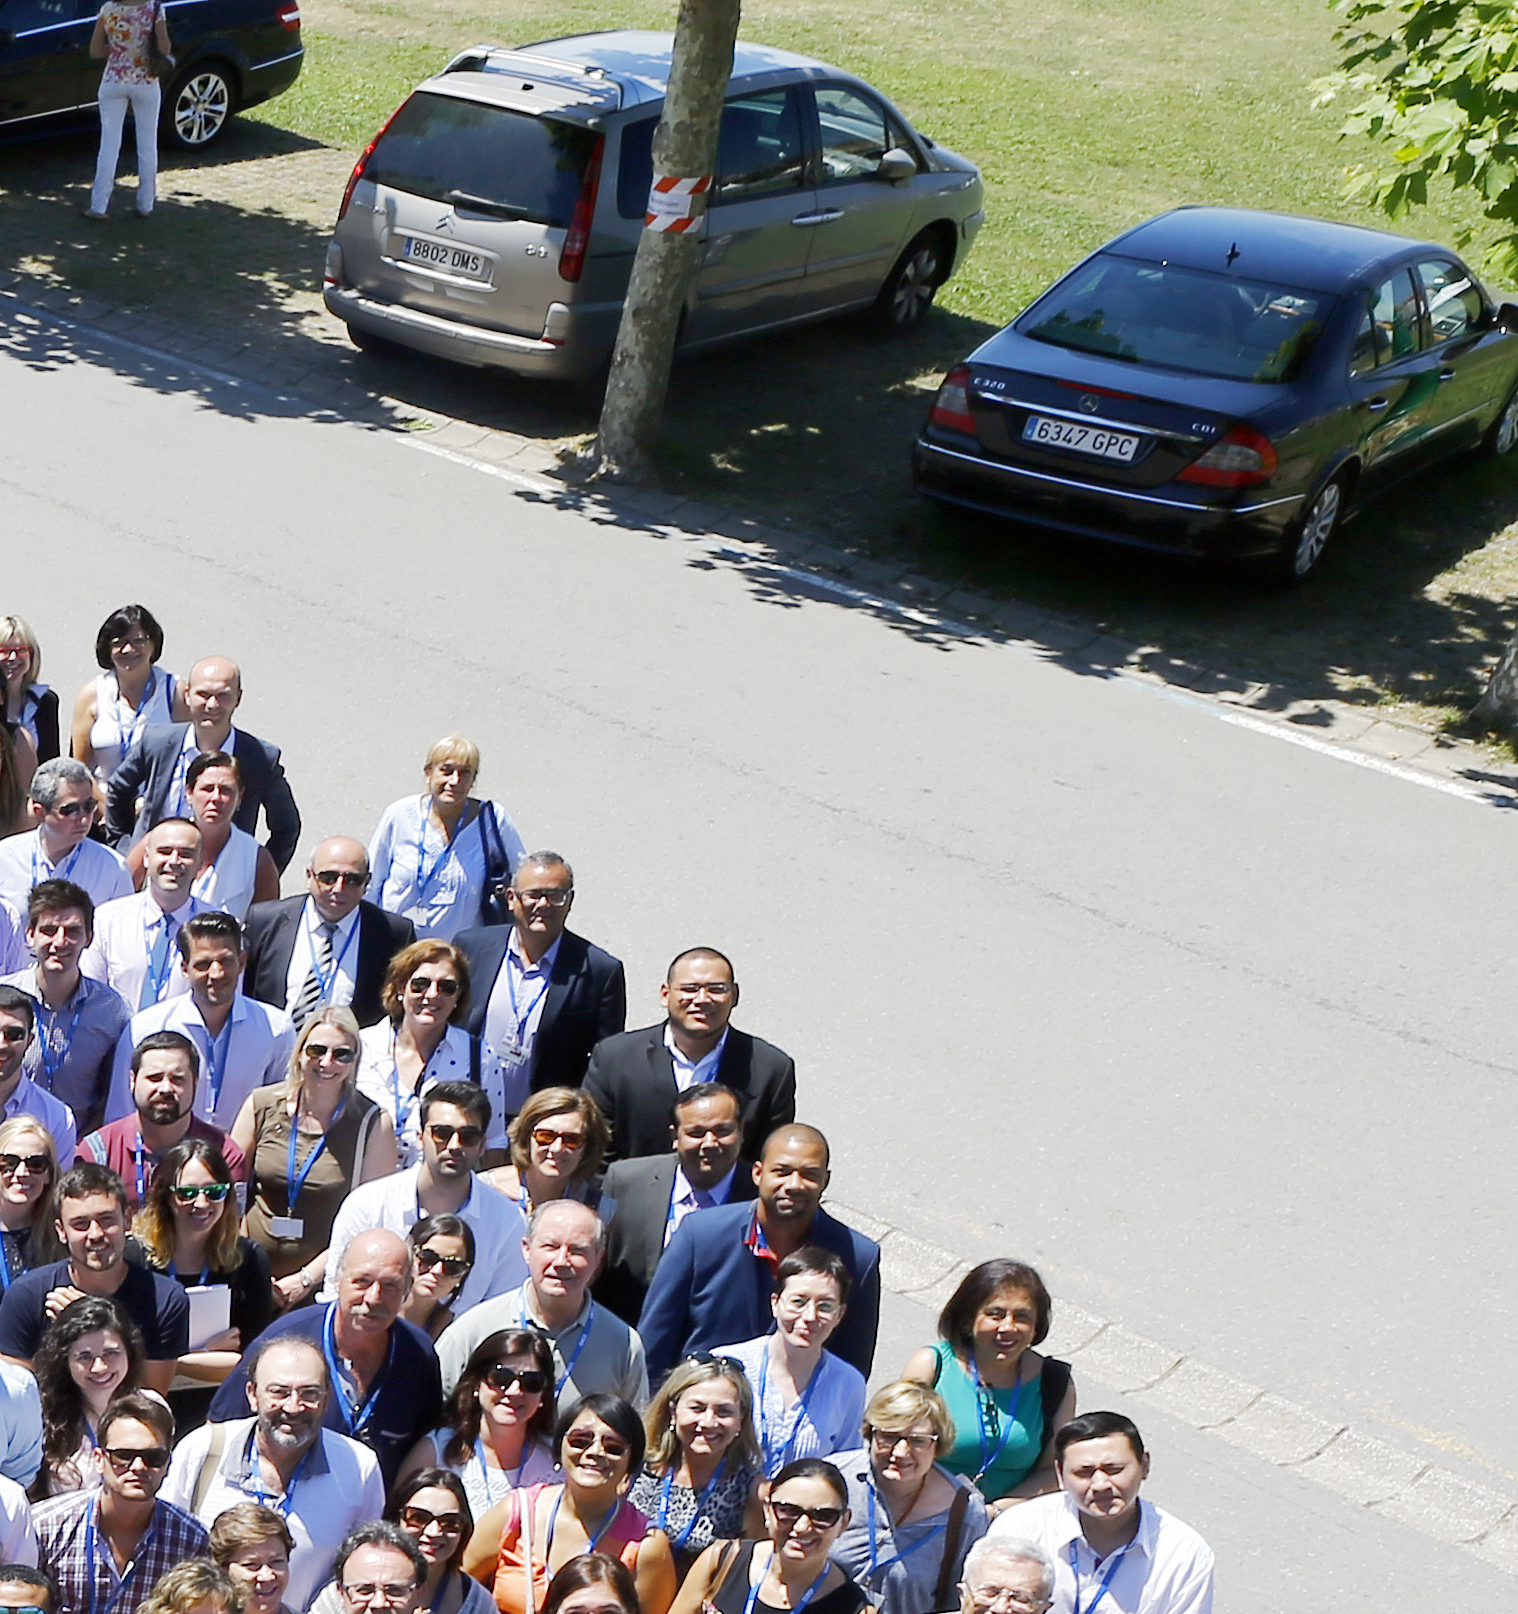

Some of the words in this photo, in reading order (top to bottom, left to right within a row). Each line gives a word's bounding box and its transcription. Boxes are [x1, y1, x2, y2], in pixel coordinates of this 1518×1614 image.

[414, 240, 448, 264] 8802
[452, 252, 479, 272] DMS
[1037, 421, 1088, 446] 6347
[1092, 431, 1133, 456] GPC
